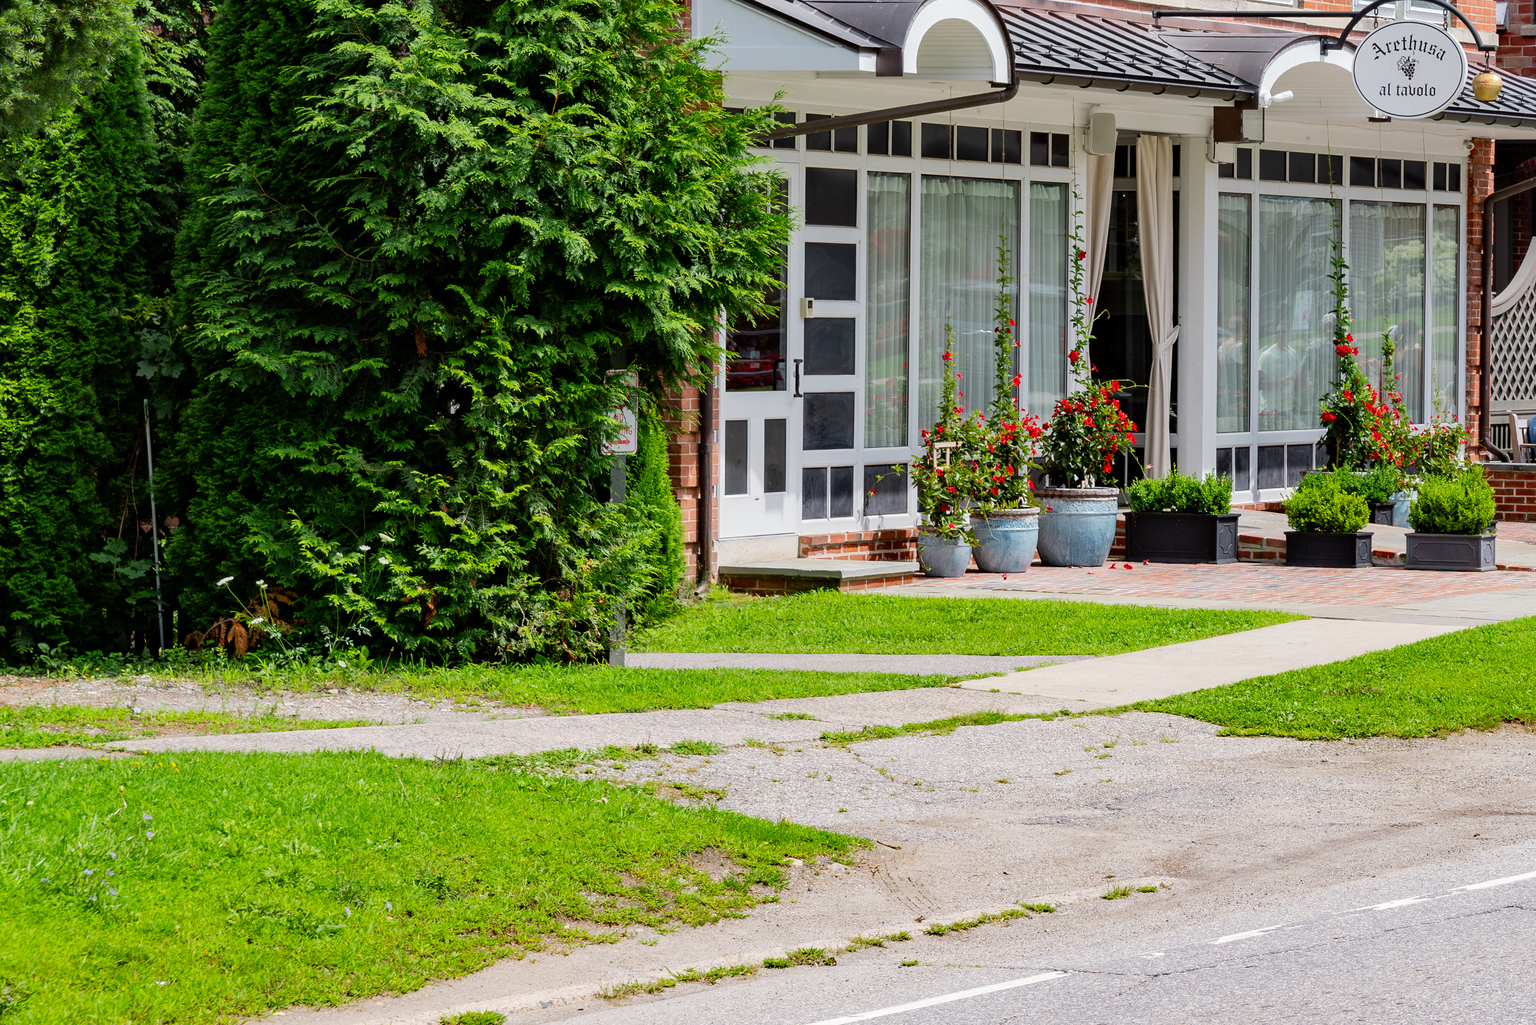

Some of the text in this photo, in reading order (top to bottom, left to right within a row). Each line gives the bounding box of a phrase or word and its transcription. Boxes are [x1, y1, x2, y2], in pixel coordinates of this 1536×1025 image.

[1372, 34, 1447, 61] Arethusa
[1379, 82, 1436, 97] al tavolo
